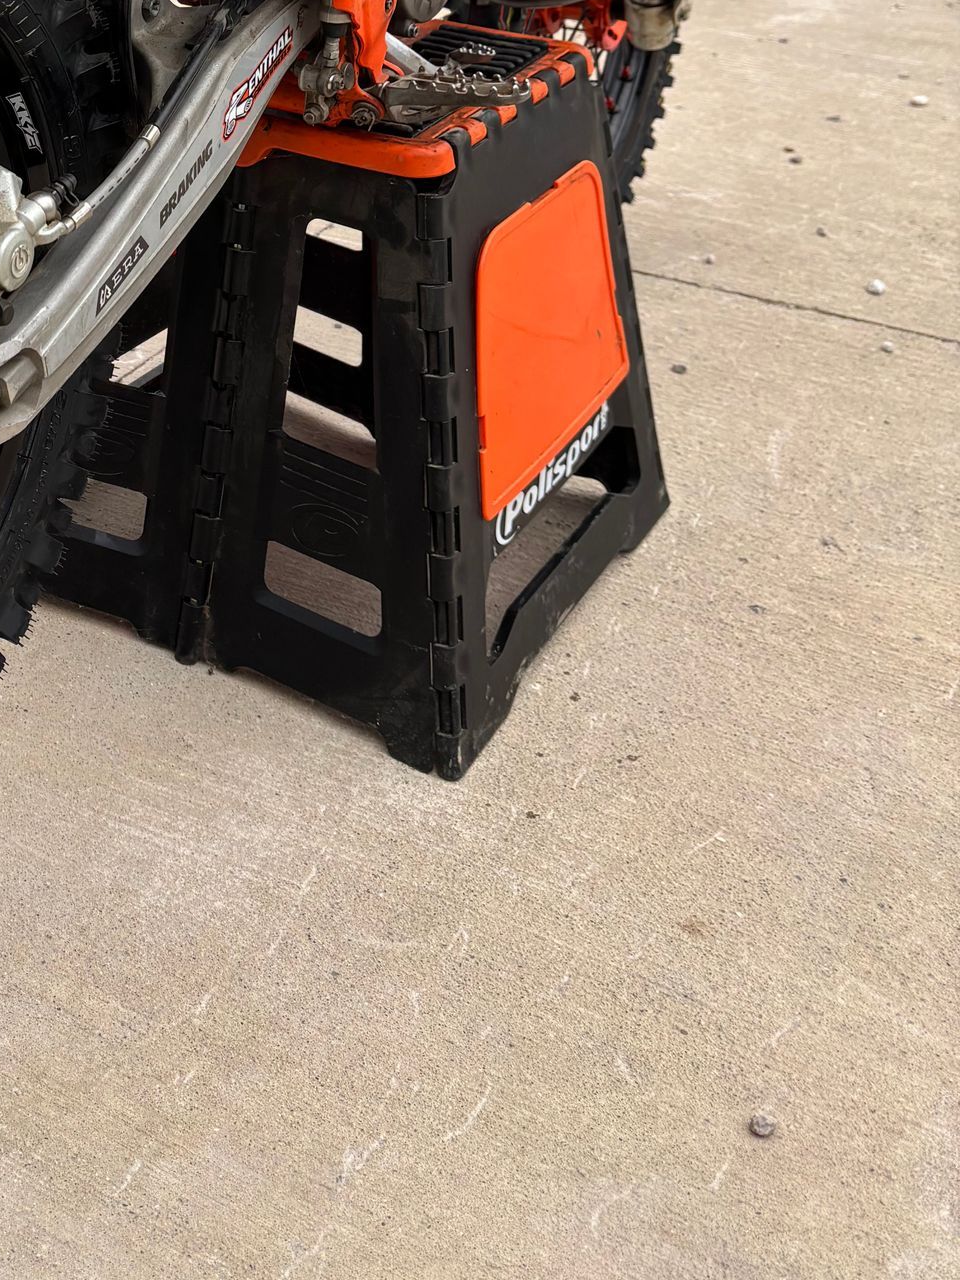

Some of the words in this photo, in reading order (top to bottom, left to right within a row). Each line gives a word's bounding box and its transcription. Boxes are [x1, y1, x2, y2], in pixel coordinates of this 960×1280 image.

[224, 28, 292, 138] RENTHAL
[159, 139, 213, 229] BRAKING
[501, 401, 609, 539] Polisport
